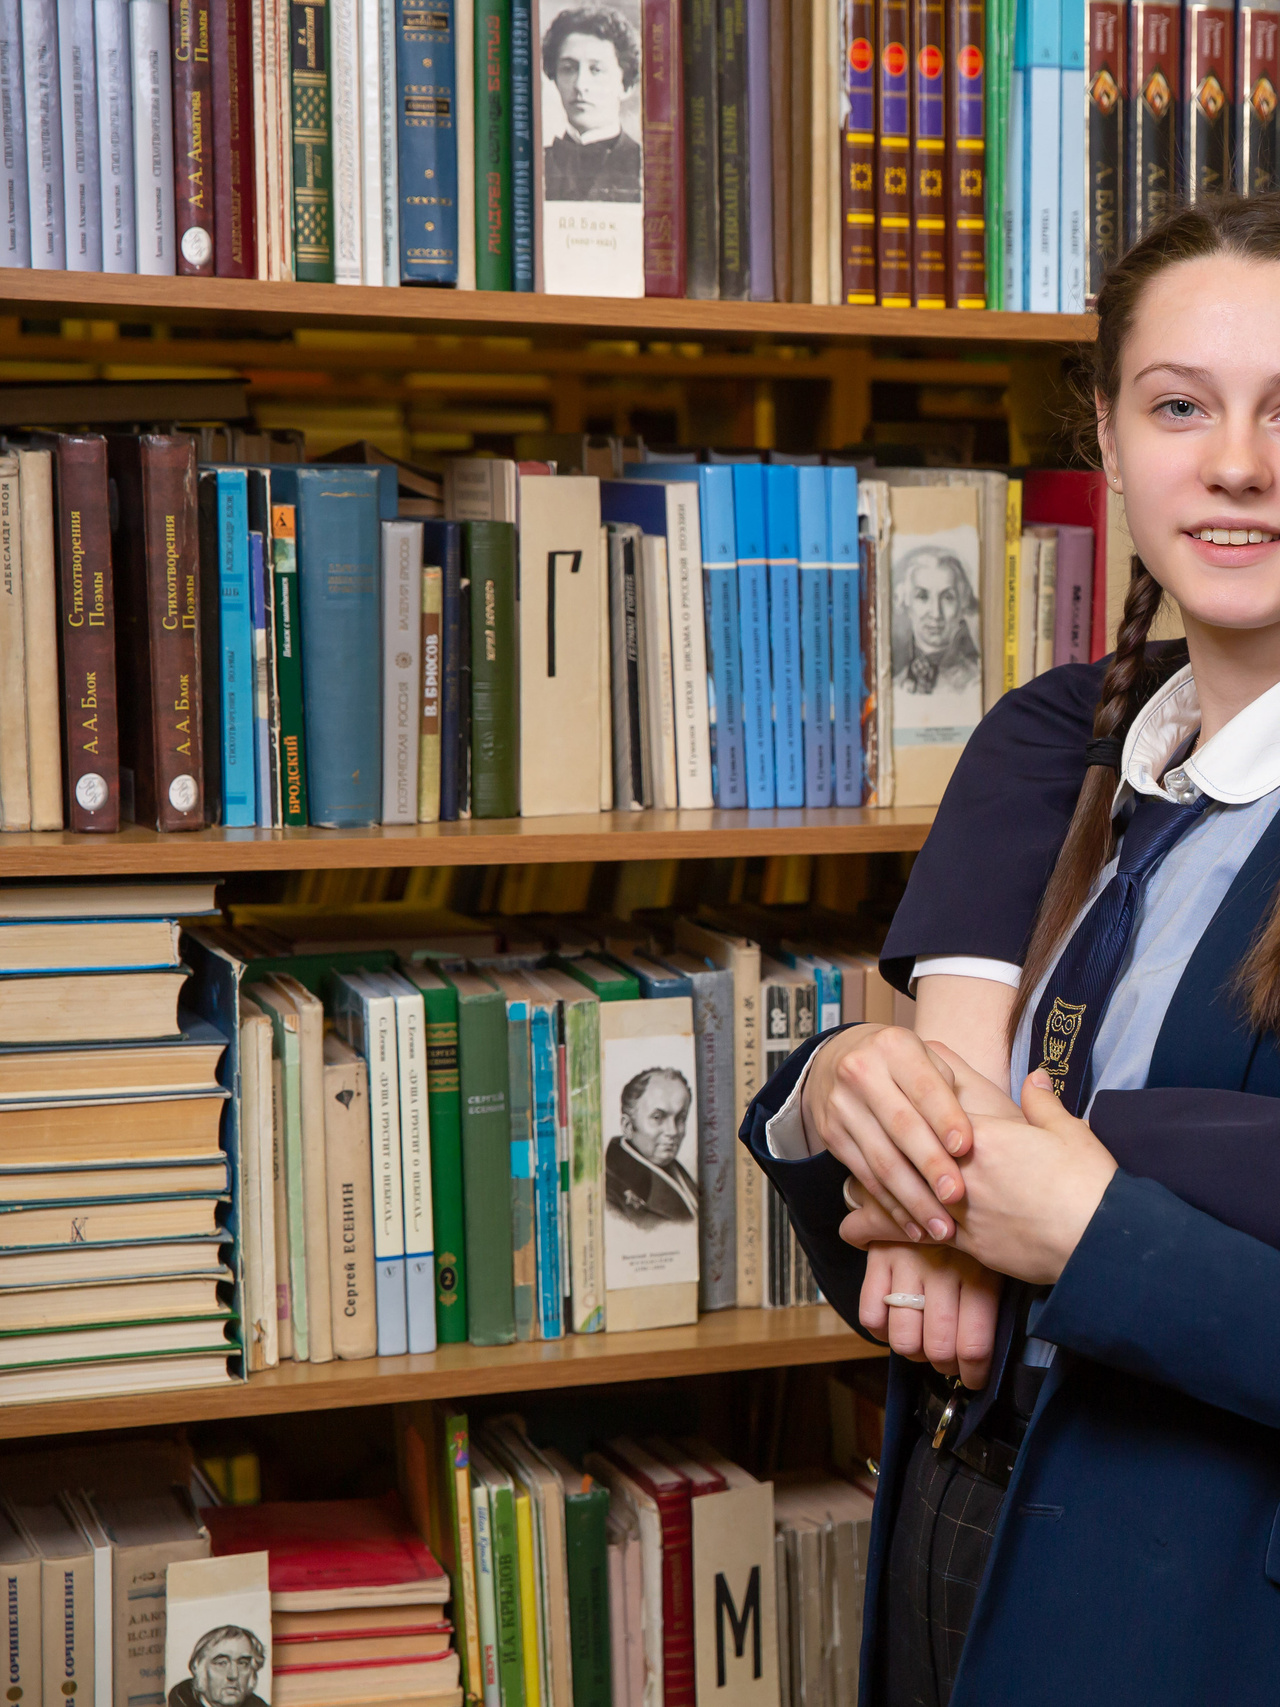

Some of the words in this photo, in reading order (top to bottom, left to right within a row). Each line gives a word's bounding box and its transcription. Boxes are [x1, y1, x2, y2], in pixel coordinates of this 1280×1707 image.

[193, 9, 209, 62] Поэмы
[486, 15, 500, 92] БЕЛЫЙ
[511, 6, 528, 66] ЗВЕЗДЫ
[186, 90, 203, 163] Ахматова
[512, 74, 530, 140] ДНЕВНЫЕ
[721, 103, 739, 155] БЛОК
[188, 167, 203, 186] А.
[513, 159, 530, 233] БЕРГГОЛЬЦ
[1095, 161, 1113, 184] А.
[1147, 162, 1165, 187] А.
[188, 189, 204, 209] А.
[488, 171, 502, 255] АНДРЕЙ
[722, 162, 741, 272] АЛЕКСАНДР
[231, 188, 243, 264] АЛЕКСАНДР
[515, 236, 531, 279] ОЛЬГА
[1, 482, 11, 518] БЛОК
[224, 494, 235, 518] БЛОК
[224, 520, 236, 572] АЛЕКСАНДР
[676, 503, 688, 552] ПОЭЗИИ
[2, 521, 13, 595] АЛЕКСАНДР
[67, 510, 85, 628] Стихотворения
[162, 514, 180, 631] Стихотворения
[399, 537, 411, 581] БРЮСОВ
[88, 571, 106, 627] Поэмы
[181, 574, 197, 630] Поэмы
[679, 557, 690, 609] РУССКОЙ
[398, 584, 410, 631] ВАЛЕРИЙ
[547, 550, 582, 678] Г
[681, 613, 690, 622] О
[282, 630, 293, 658] Пейзаж
[424, 633, 439, 698] БРЮСОВ
[682, 624, 692, 672] ПИСЬМА
[80, 671, 98, 709] Блок
[174, 674, 191, 711] Блок
[397, 681, 409, 728] РОССИЯ
[424, 700, 438, 717] В.
[684, 680, 696, 719] СТИХИ
[82, 712, 98, 732] А.
[83, 735, 98, 755] А.
[175, 714, 191, 733] А.
[227, 690, 238, 766] СТИХОТВОРЕНИЯ
[176, 737, 191, 756] А.
[283, 735, 301, 815] БРОДСКИЙ
[397, 734, 409, 815] ПОЭТИЧЕСКАЯ
[379, 1029, 389, 1062] Есенин
[407, 1025, 417, 1060] Есенин
[467, 1091, 505, 1105] СЕРГЕЙ
[468, 1103, 506, 1115] ЕСЕНИН
[381, 1111, 392, 1158] ГРУСТИТ
[410, 1107, 420, 1154] ГРУСТИТ
[382, 1161, 390, 1170] О
[341, 1182, 355, 1254] ЕСЕНИН
[341, 1260, 358, 1318] Сергей
[441, 1272, 453, 1287] 2
[498, 1553, 516, 1628] КРЫЛОВ
[8, 1576, 20, 1684] СОЧИНЕНИЯ
[64, 1569, 75, 1678] СОЧИНЕНИЯ
[715, 1565, 764, 1689] М
[484, 1644, 495, 1686] БАСНИ
